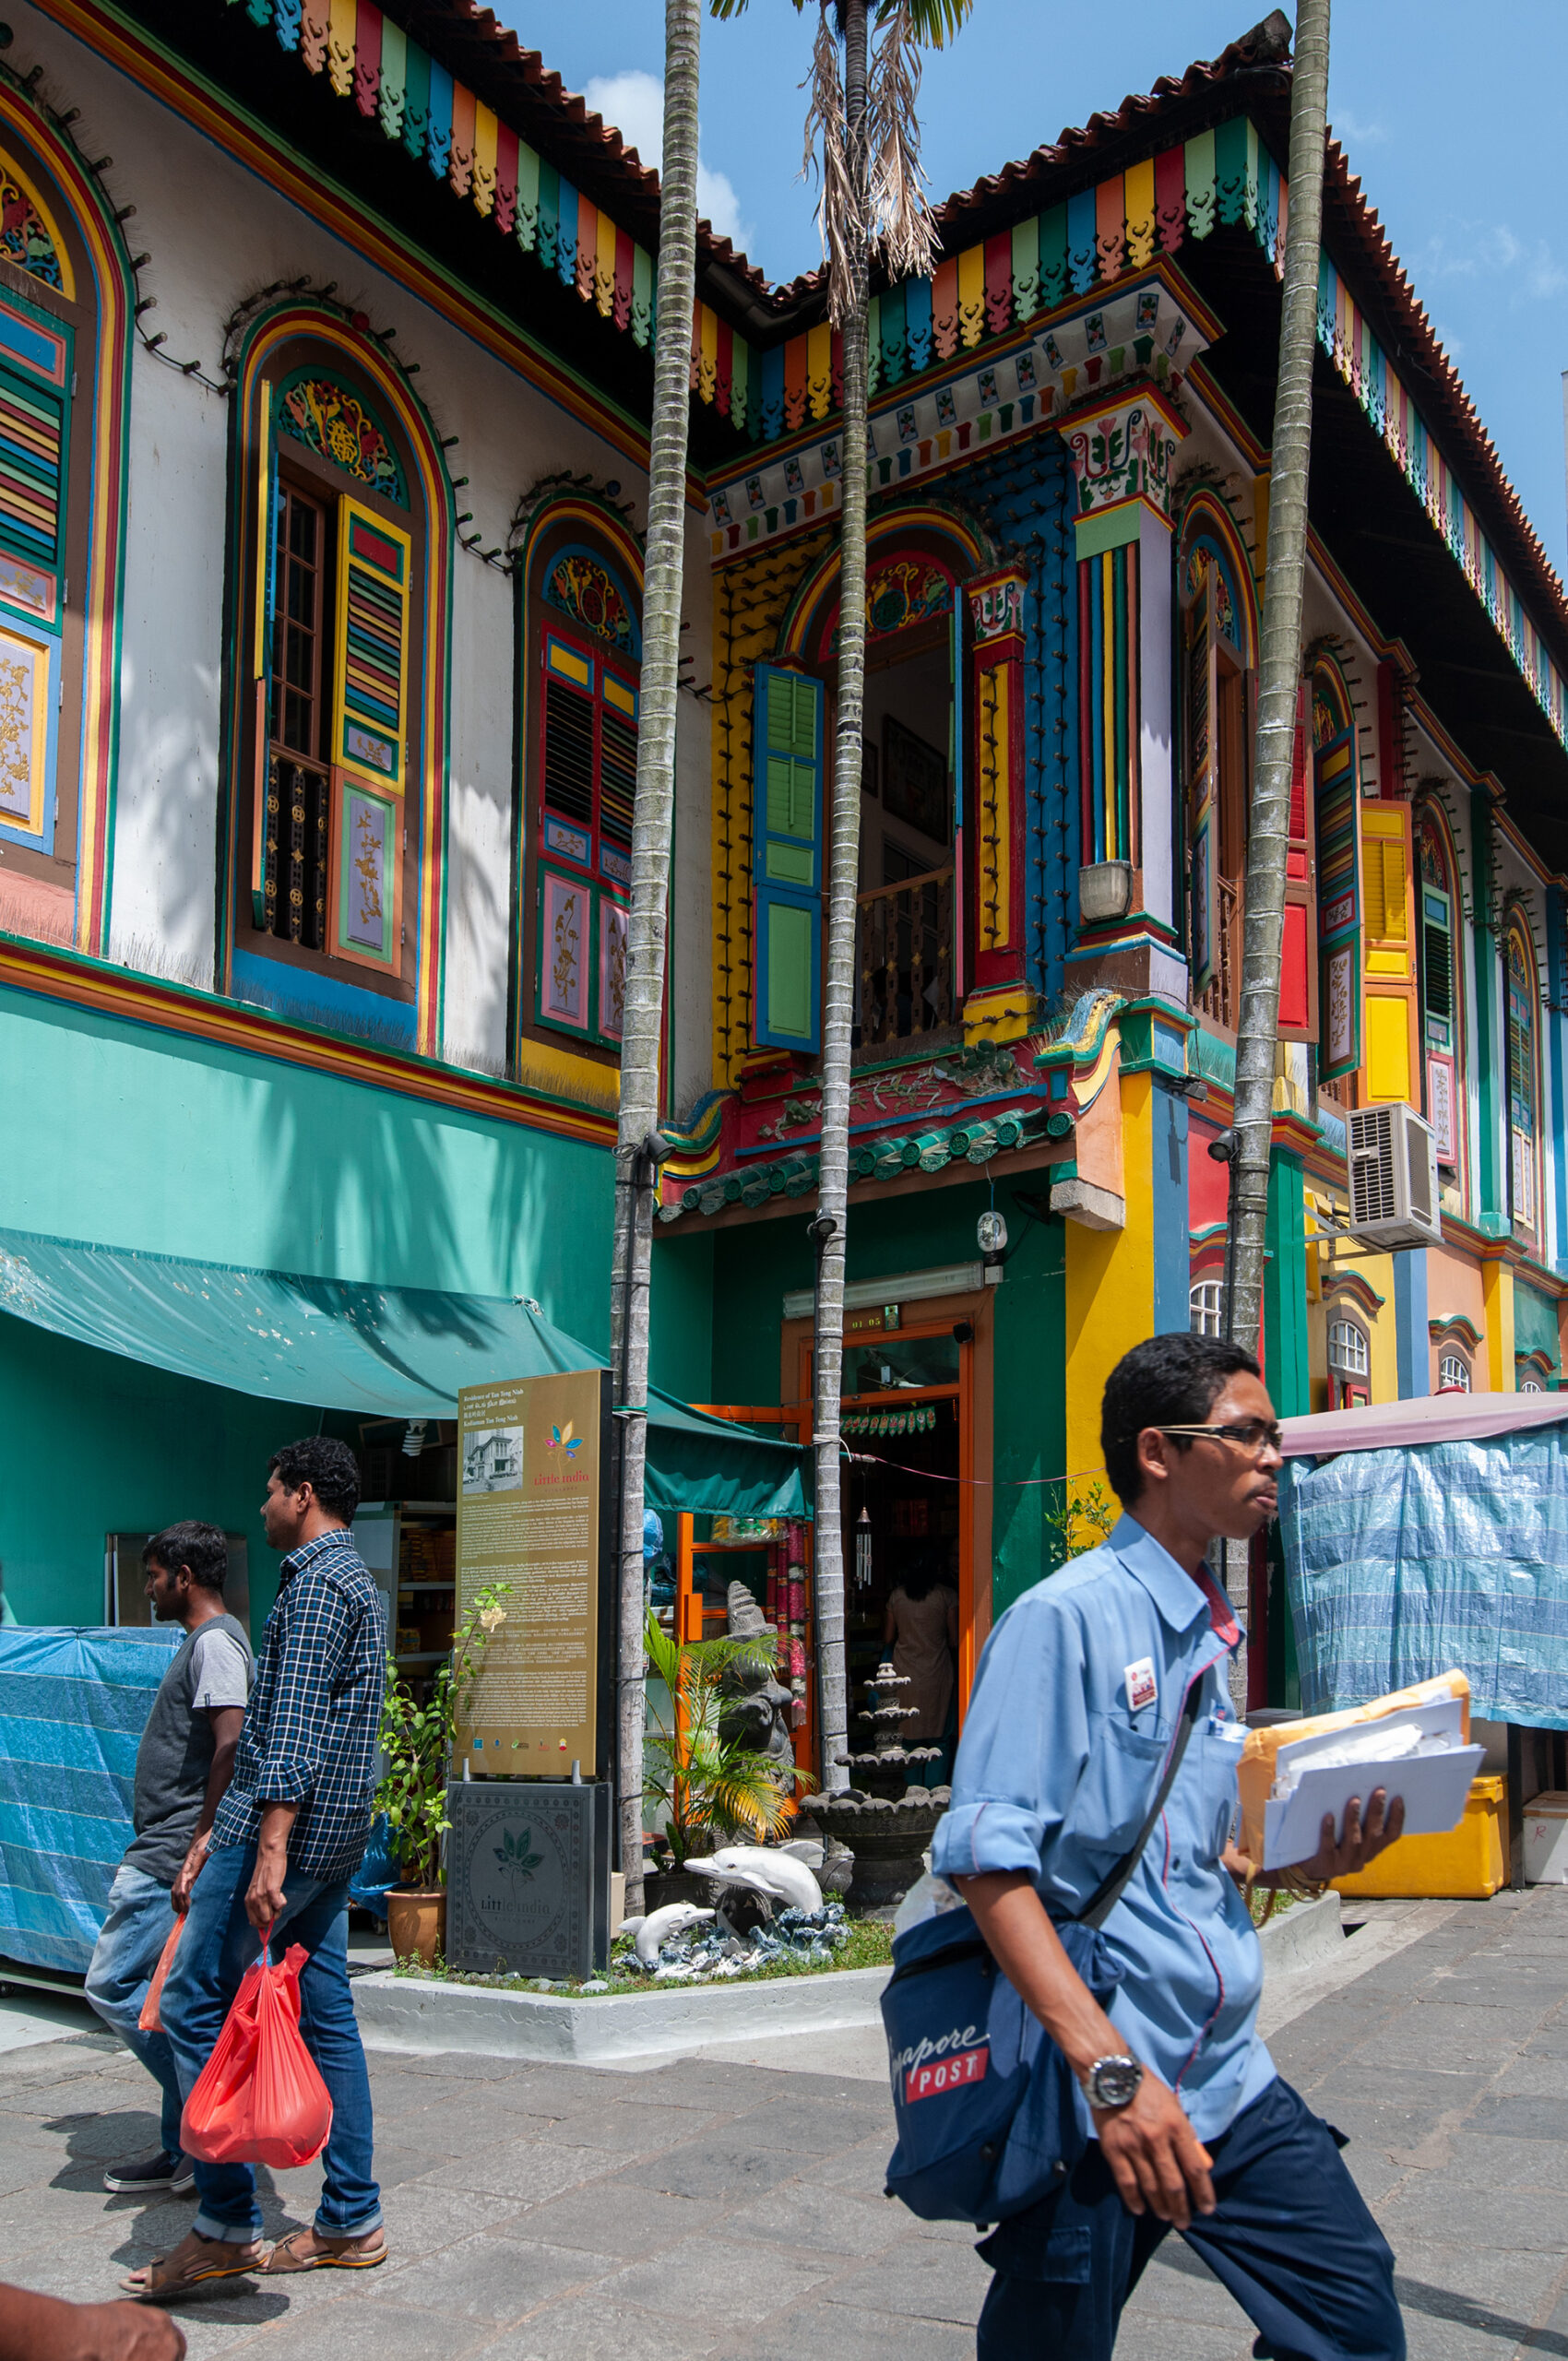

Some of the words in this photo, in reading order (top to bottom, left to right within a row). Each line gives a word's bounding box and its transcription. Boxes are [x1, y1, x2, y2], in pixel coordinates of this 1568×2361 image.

[852, 1320, 862, 1328] 01
[868, 1317, 881, 1326] 05
[534, 1472, 560, 1486] Little
[919, 2053, 977, 2093] POST
